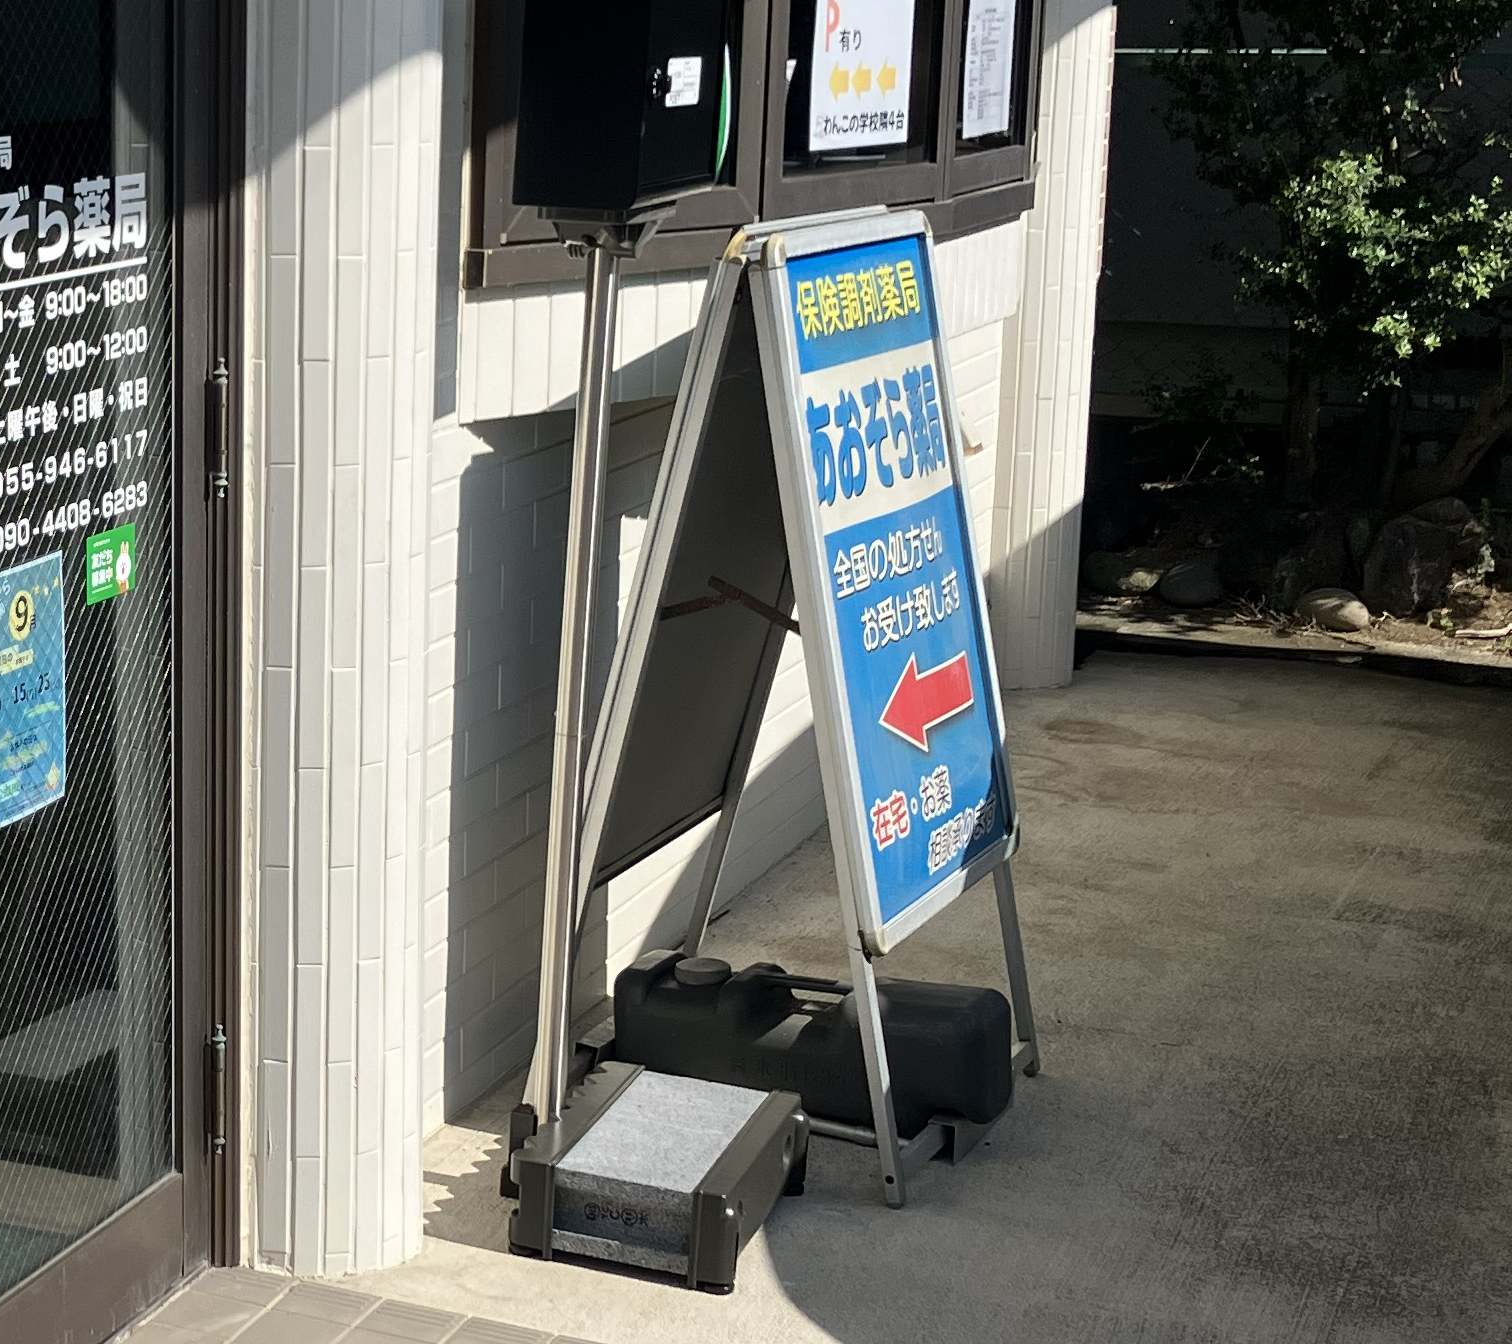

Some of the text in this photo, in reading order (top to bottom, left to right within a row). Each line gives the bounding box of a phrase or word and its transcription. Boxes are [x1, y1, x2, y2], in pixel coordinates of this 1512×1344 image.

[796, 259, 920, 340] 保険調剤薬局
[3, 353, 21, 387] 土
[805, 363, 945, 507] あおぞら薬局
[833, 516, 943, 599] 全国の処方せん
[860, 567, 961, 652] お受け致します
[870, 765, 952, 852] 在宅・お薬
